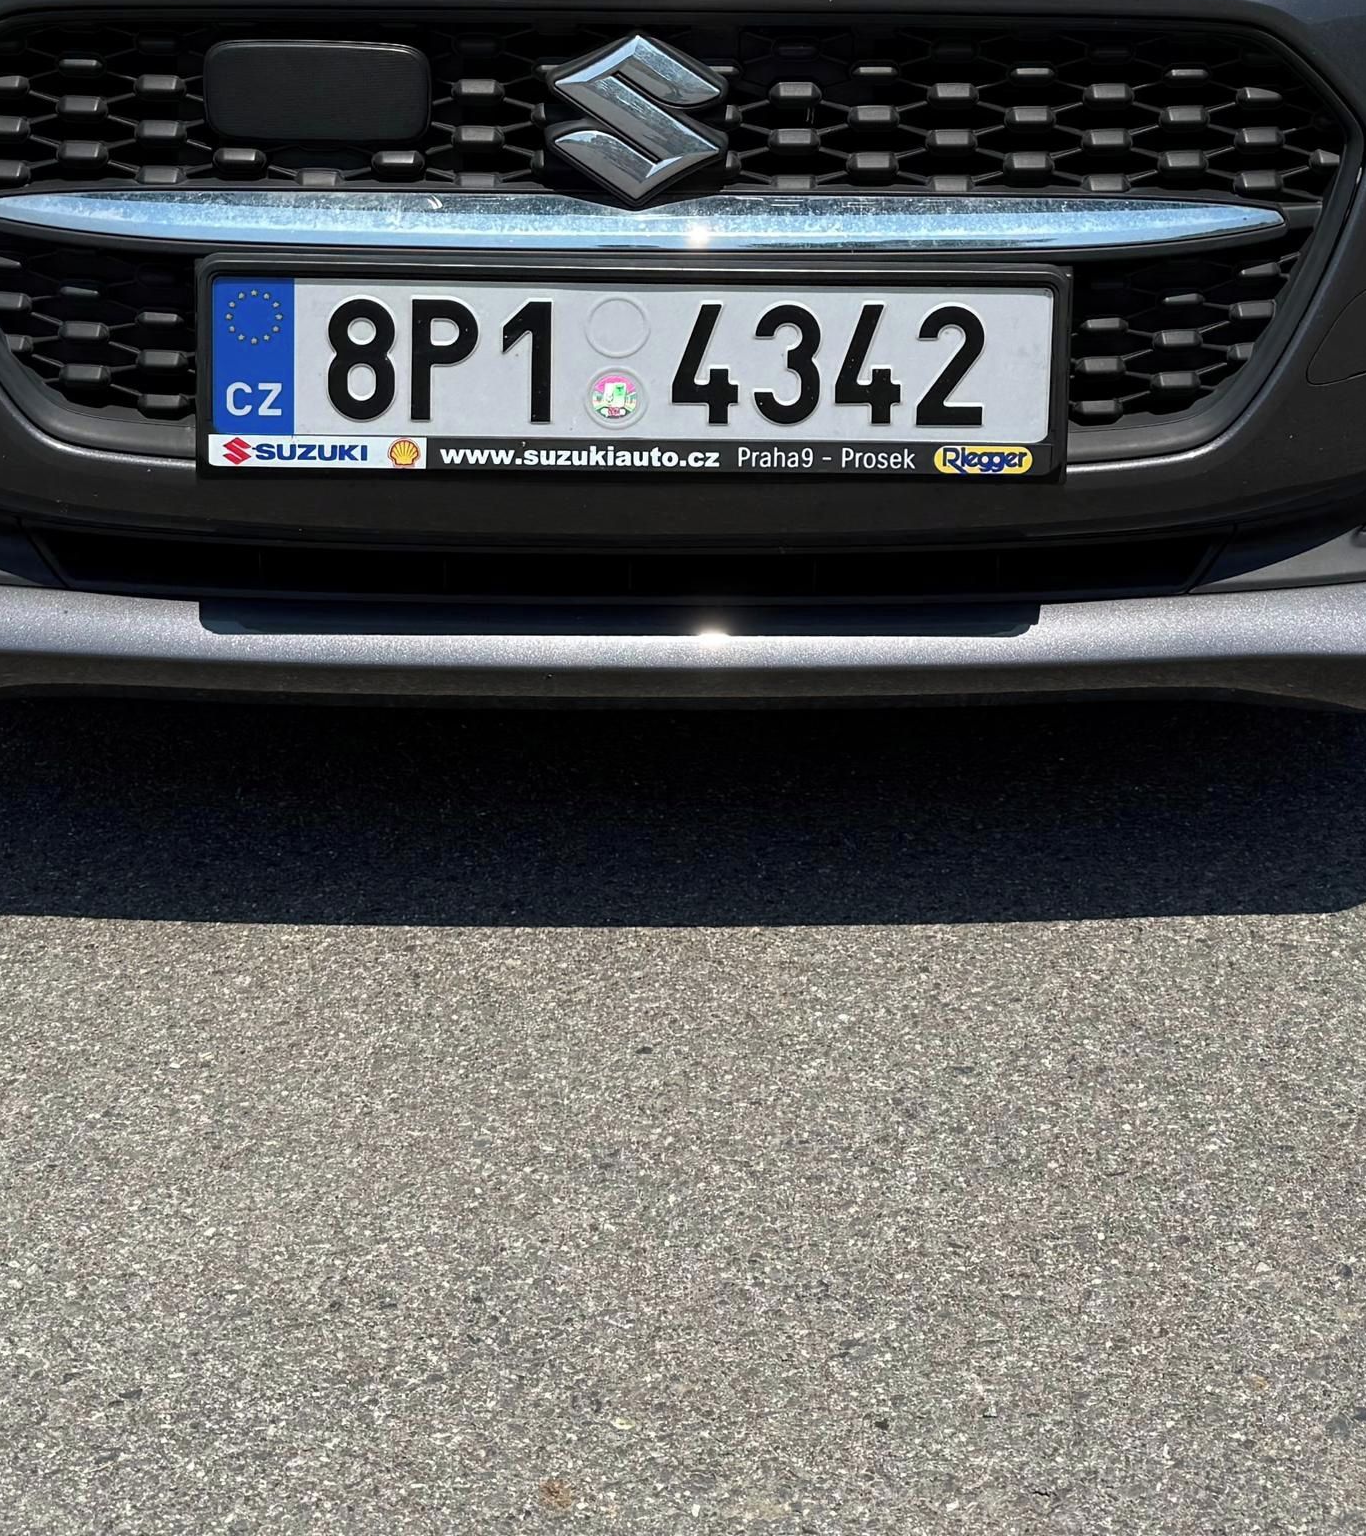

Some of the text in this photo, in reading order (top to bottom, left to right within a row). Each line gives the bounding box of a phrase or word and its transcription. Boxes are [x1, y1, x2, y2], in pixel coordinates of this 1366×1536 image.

[327, 296, 986, 426] 8P1 4342
[225, 382, 283, 417] CZ
[252, 443, 368, 462] SUZUKI
[439, 445, 721, 468] www.suzukiauto.cz
[737, 446, 814, 468] Praha9
[841, 447, 916, 470] Prosek
